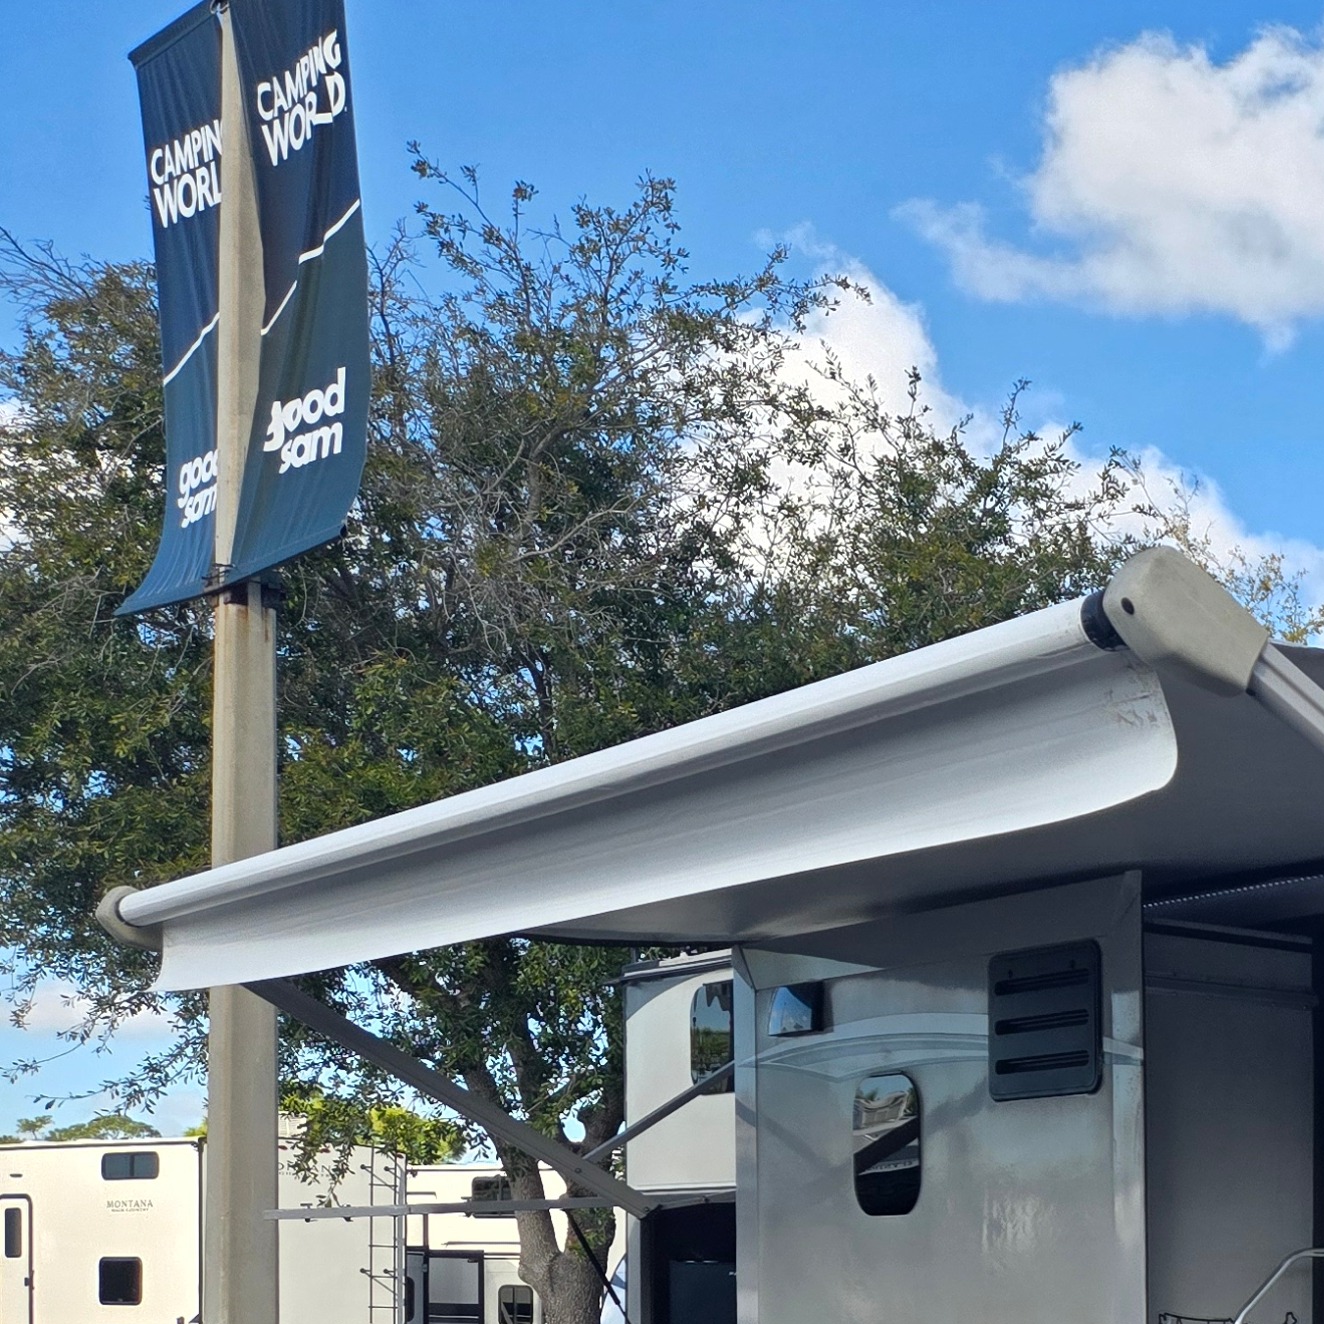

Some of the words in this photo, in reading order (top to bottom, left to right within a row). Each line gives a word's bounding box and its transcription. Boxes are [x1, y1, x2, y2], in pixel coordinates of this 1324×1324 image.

[257, 28, 342, 121] CAMPING
[150, 119, 222, 185] CAMPIN
[153, 161, 222, 228] WORL
[263, 366, 346, 452] good
[278, 421, 343, 474] sam
[106, 1199, 153, 1208] MONTANA
